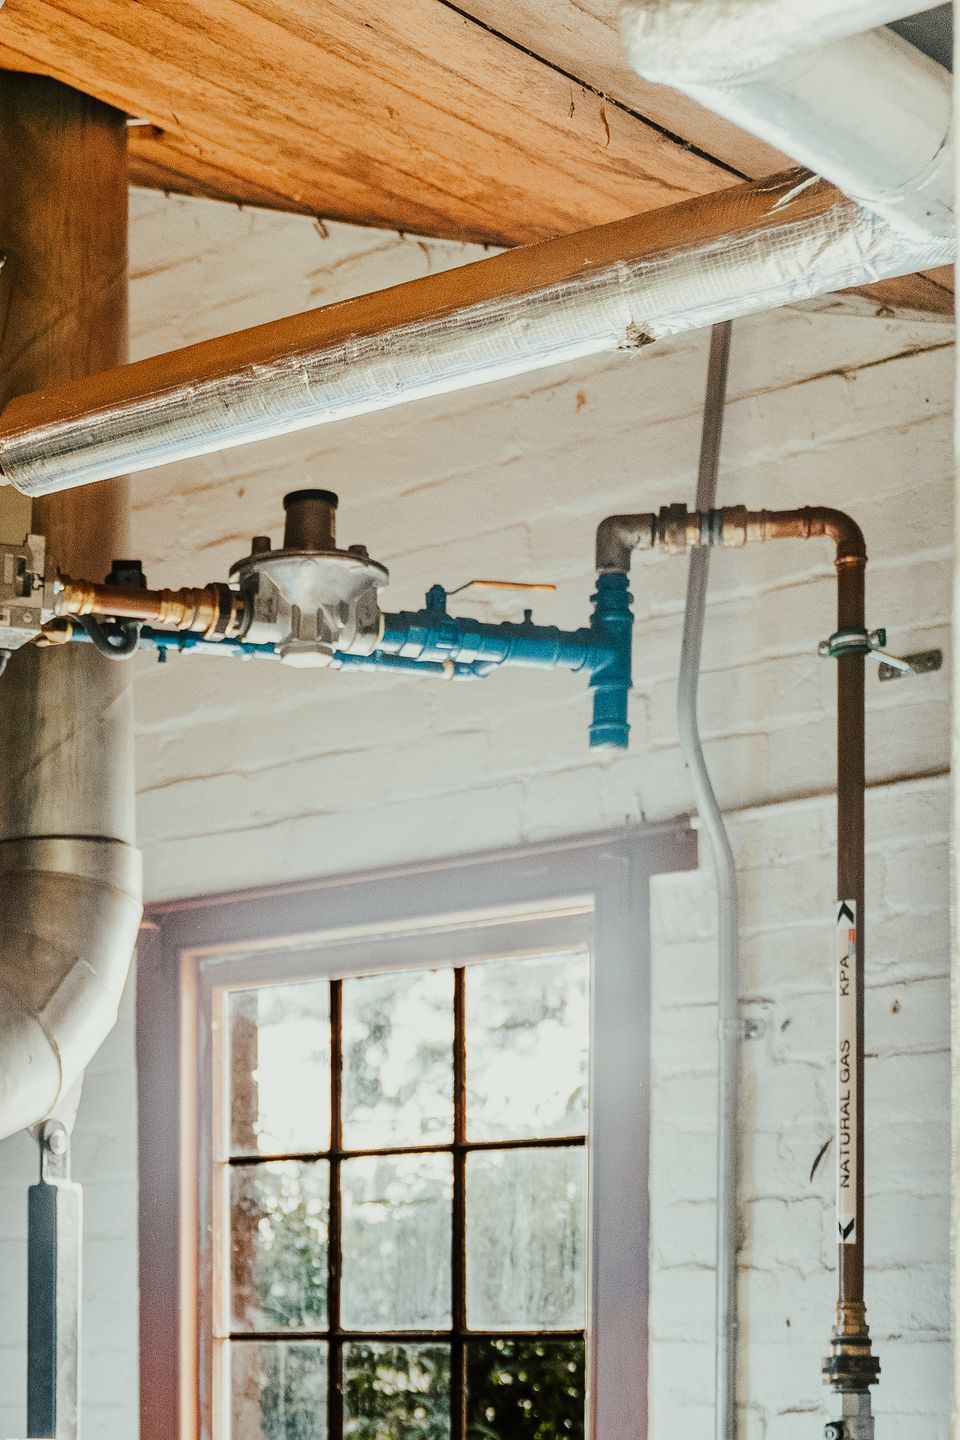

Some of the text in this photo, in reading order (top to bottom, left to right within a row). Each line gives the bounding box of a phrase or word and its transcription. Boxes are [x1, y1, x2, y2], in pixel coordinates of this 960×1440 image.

[839, 954, 851, 1189] NATURAL GAS KPA
